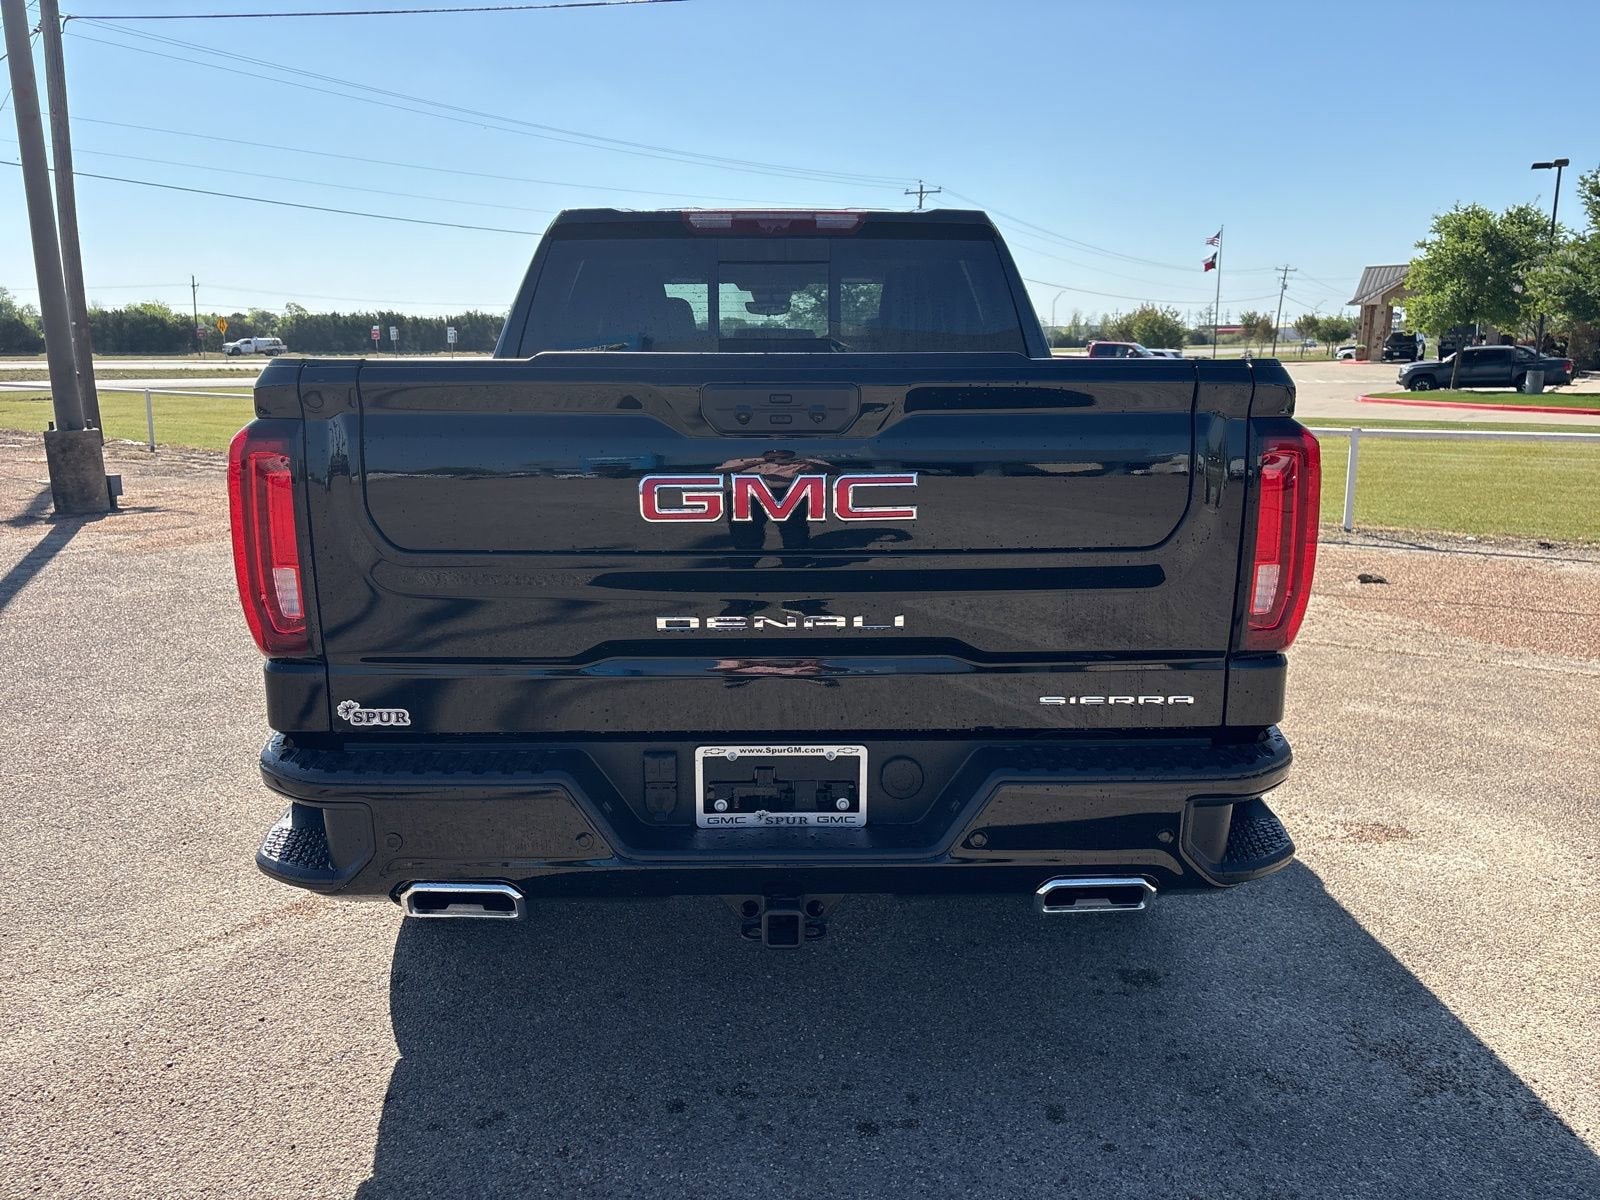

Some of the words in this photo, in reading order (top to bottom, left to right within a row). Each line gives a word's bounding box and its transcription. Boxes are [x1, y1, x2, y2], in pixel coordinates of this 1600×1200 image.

[639, 473, 918, 522] GMC
[656, 615, 905, 631] DENALI
[1039, 695, 1195, 705] SIERRA
[353, 711, 407, 723] SPUR
[739, 747, 825, 755] www.SpurGM.com
[765, 817, 808, 825] SPUR
[816, 816, 857, 824] GMC
